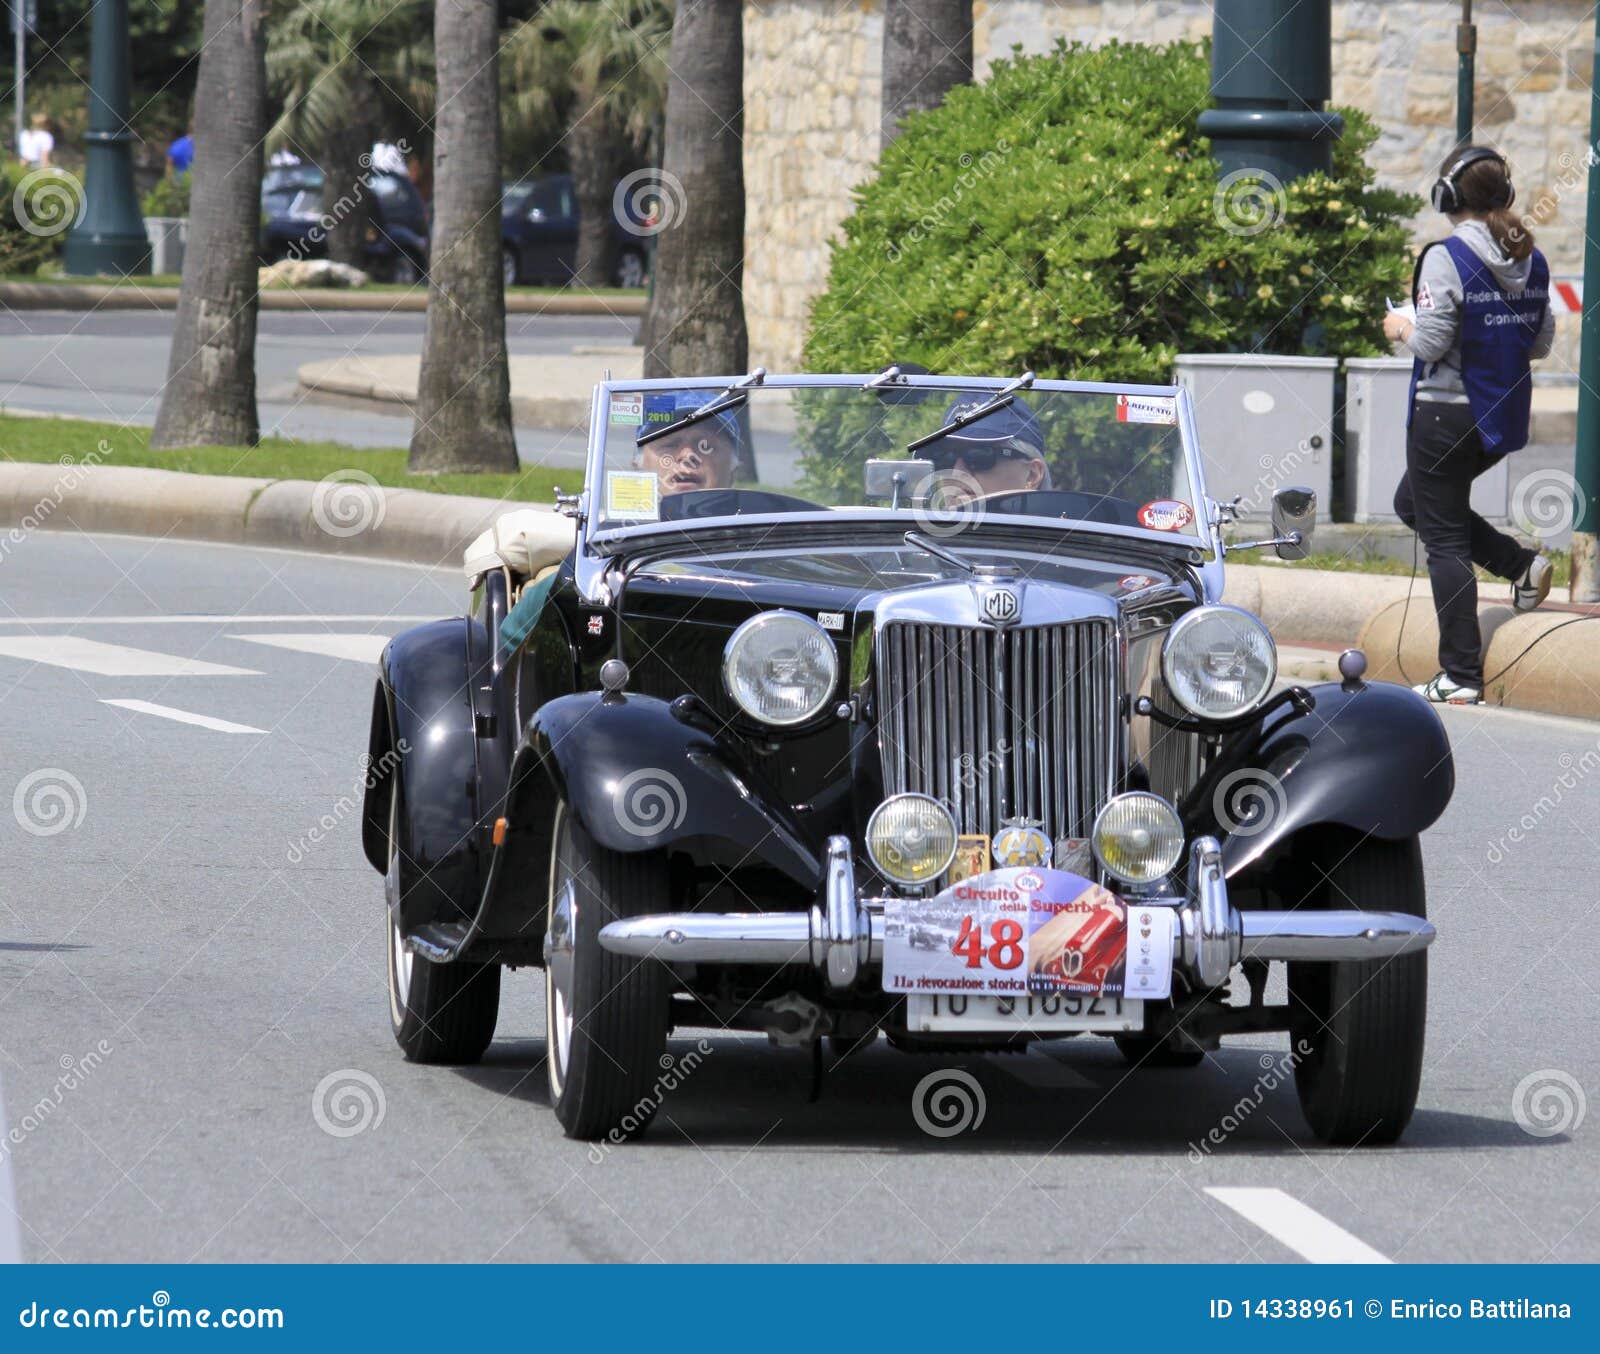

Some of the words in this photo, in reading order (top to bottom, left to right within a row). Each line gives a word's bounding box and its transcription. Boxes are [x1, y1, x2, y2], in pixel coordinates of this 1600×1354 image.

[648, 413, 670, 422] 2010
[988, 592, 1017, 616] MG
[955, 887, 1020, 901] Circuito
[999, 901, 1027, 912] della
[1030, 899, 1102, 915] Superba
[951, 914, 1024, 970] 48
[1030, 971, 1061, 981] Genova
[916, 976, 984, 990] rievocazione
[988, 977, 1025, 991] storica
[1068, 984, 1099, 992] maggio
[1101, 983, 1122, 992] 2010
